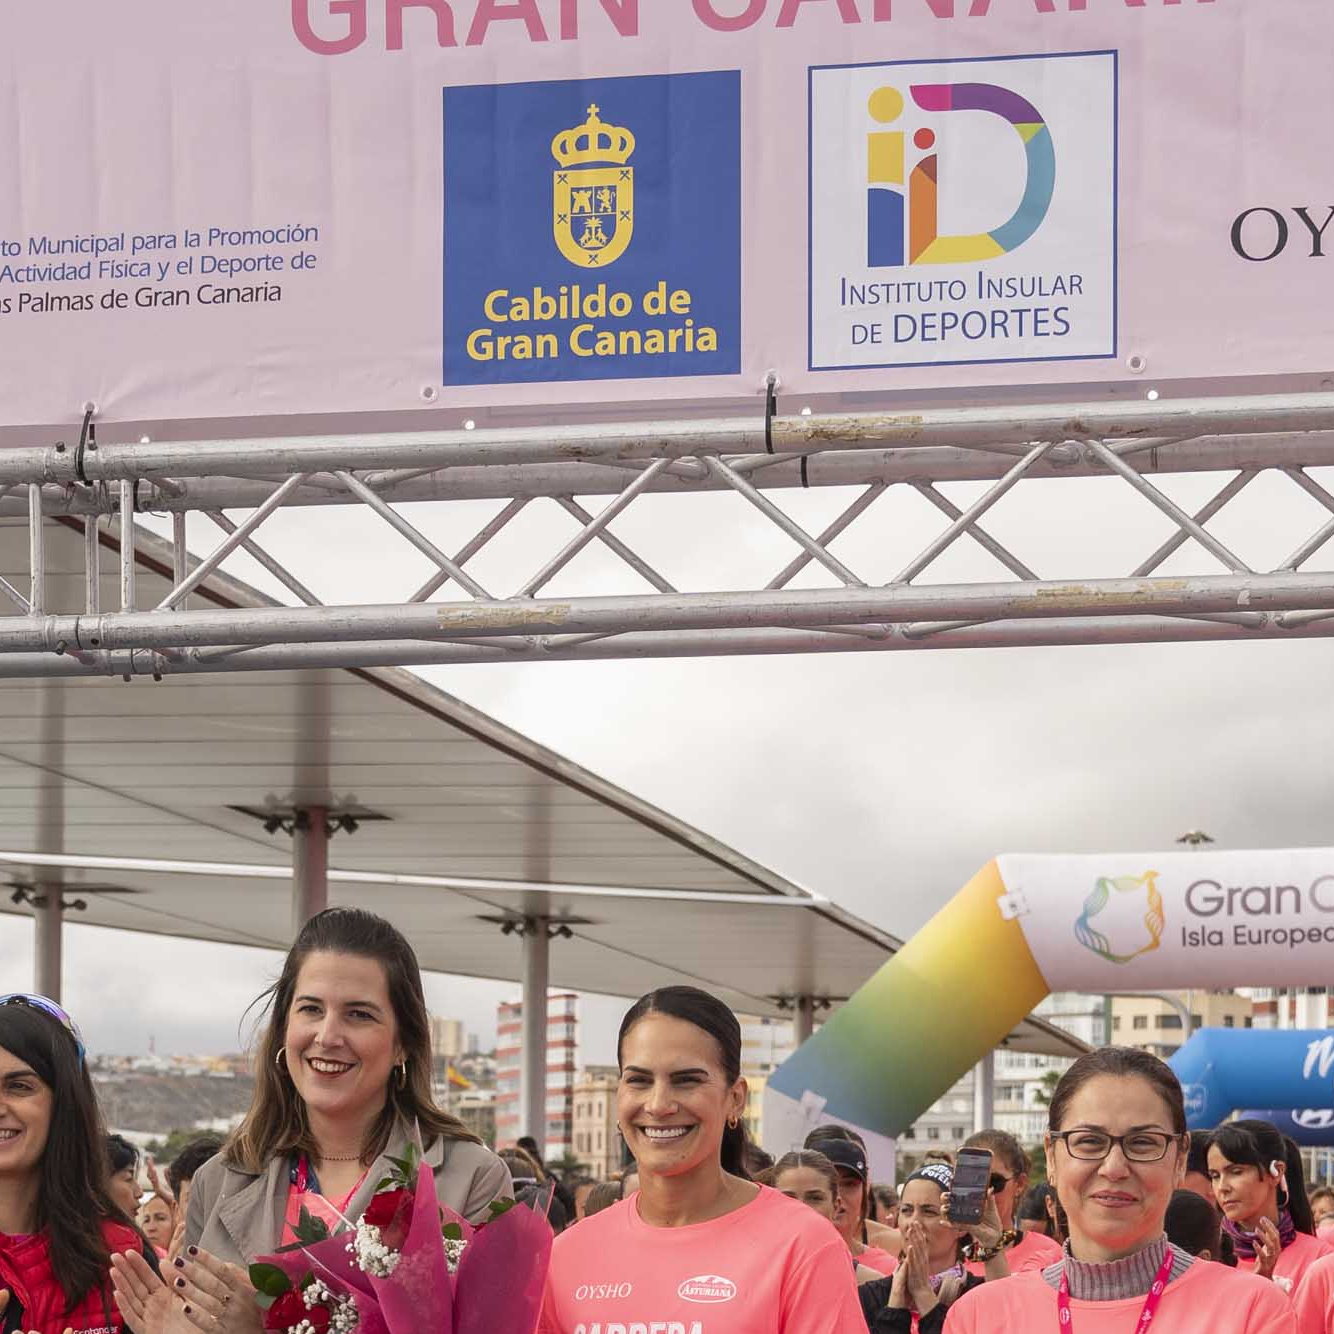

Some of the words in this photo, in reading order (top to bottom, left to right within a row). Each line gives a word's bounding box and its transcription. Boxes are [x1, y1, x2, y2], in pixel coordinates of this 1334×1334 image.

[29, 232, 124, 261] Municipal
[131, 235, 178, 258] para
[182, 230, 203, 249] la
[207, 223, 319, 250] Promoción
[98, 255, 151, 279] Física
[156, 260, 169, 280] y
[176, 253, 196, 275] el
[200, 250, 287, 277] Deporte
[293, 250, 317, 271] de
[19, 290, 94, 315] Palmas
[100, 287, 128, 309] de
[135, 284, 187, 308] Gran
[193, 280, 281, 306] Canaria
[483, 287, 632, 322] Cabildo
[643, 282, 692, 315] de
[840, 275, 965, 306] INSTITUTO
[976, 269, 1083, 300] INSULAR
[467, 326, 560, 361] Gran
[568, 320, 718, 354] Canaria
[853, 323, 884, 345] DE
[892, 304, 1071, 344] DEPORTES
[1184, 878, 1302, 920] Gran
[1181, 921, 1224, 949] Isla
[574, 1282, 633, 1301] OYSHO
[682, 1284, 732, 1298] ASTURIANA
